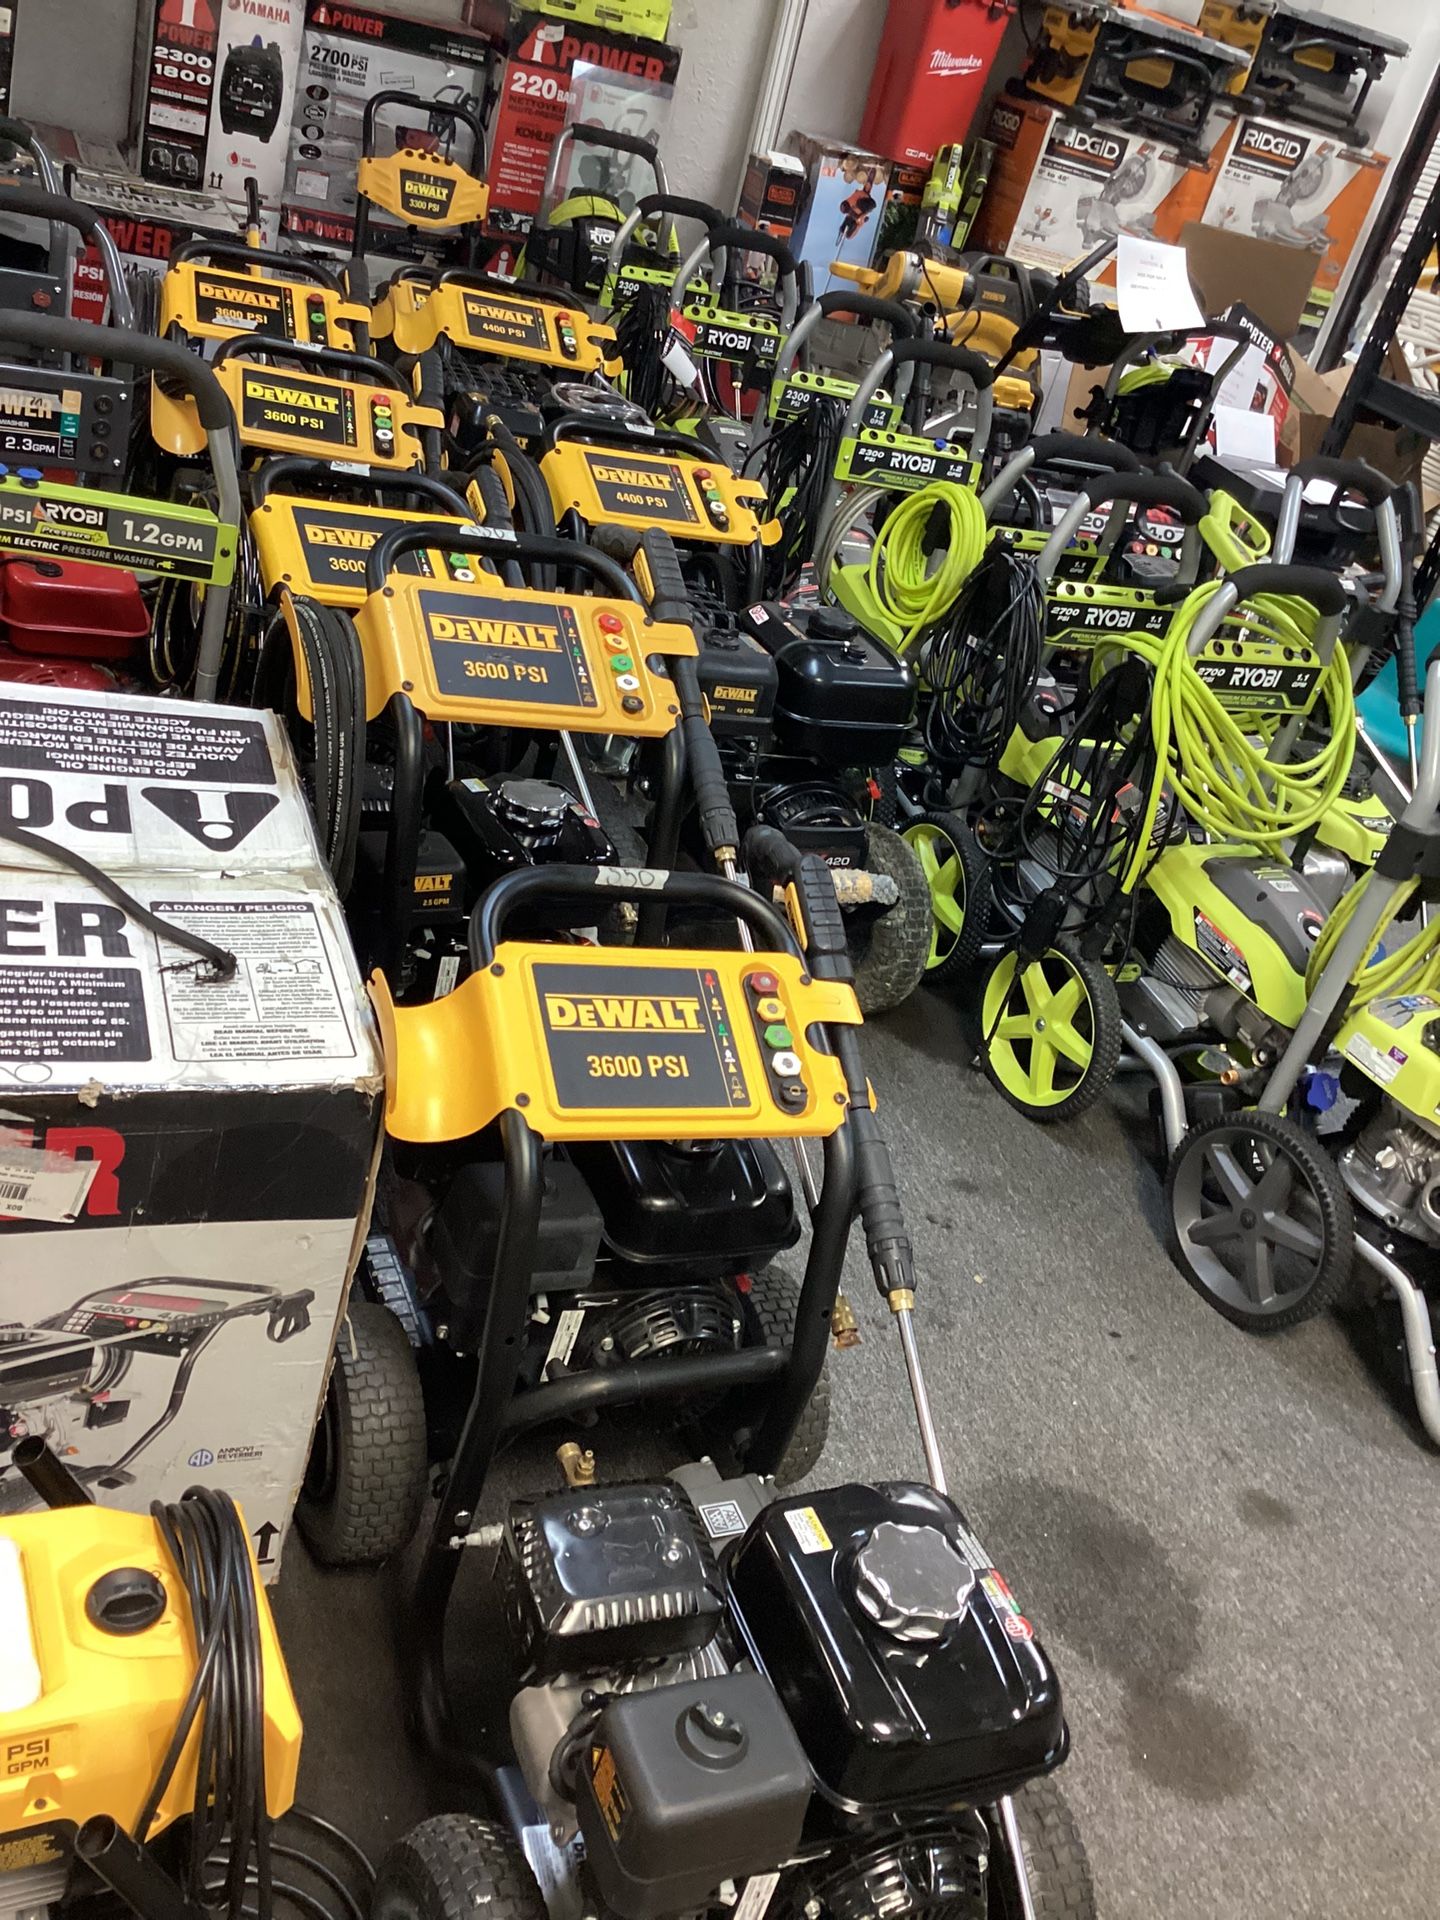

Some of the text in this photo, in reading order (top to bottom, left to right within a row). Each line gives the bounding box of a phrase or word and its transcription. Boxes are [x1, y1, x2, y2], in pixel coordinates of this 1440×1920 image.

[242, 0, 290, 24] YAMAHA
[158, 22, 213, 51] POWER
[154, 46, 212, 69] 2300
[311, 45, 350, 68] 2700
[930, 49, 983, 69] Milwaukee
[351, 58, 368, 73] PSI
[154, 63, 212, 86] 1800
[511, 71, 558, 99] 220
[1242, 128, 1301, 158] RIDGID
[409, 199, 441, 212] 3300 PSI
[78, 265, 104, 281] PSI
[618, 280, 640, 292] 2300
[199, 285, 280, 311] DEWALT
[246, 312, 268, 325] PSI
[466, 303, 535, 327] DEWALT
[483, 322, 526, 338] 4400 PSI
[707, 329, 752, 351] RYOBI
[763, 338, 775, 348] 1.2
[246, 382, 339, 415] DEWALT
[785, 389, 810, 403] 2300
[0, 393, 52, 419] WER
[264, 409, 324, 430] 3600 PSI
[873, 409, 886, 420] 1.2
[858, 448, 885, 458] 2300
[889, 452, 936, 475] RYOBI
[949, 464, 964, 472] 1.2
[591, 465, 673, 490] DEWALT
[616, 491, 668, 508] 4400 PSI
[3, 507, 31, 524] PSI
[46, 503, 104, 526] RYOBI
[14, 537, 155, 567] ELECTRIC PRESSURE WASHER
[1051, 606, 1080, 617] 2700
[1085, 607, 1136, 629] RYOBI
[1150, 615, 1163, 624] 1.1
[429, 614, 559, 650] DEWALT
[463, 660, 549, 684] 3600 PSI
[1197, 667, 1225, 677] 2700
[1229, 667, 1283, 688] RYOBI
[1296, 673, 1310, 681] 1.1
[714, 686, 758, 702] DEWALT
[43, 707, 190, 726] ACEITE DE MOTOR!
[73, 718, 216, 736] FUNCIONAMIENTO
[88, 727, 109, 735] EL
[113, 729, 168, 740] PONER
[0, 737, 69, 750] MOTEUR
[70, 735, 92, 743] EN
[97, 736, 162, 748] METTRE
[74, 743, 136, 755] L'HUILE
[166, 750, 238, 761] AJOUTEZ
[191, 744, 244, 754] AVANT
[46, 752, 196, 770] BEFORE RUNNING!
[56, 760, 188, 777] ADD ENGINE OIL
[825, 857, 850, 866] 420
[173, 904, 236, 912] DANGER
[245, 904, 308, 912] PELIGRO
[49, 970, 104, 979] Unleaded
[19, 986, 59, 996] Rating
[28, 978, 55, 986] With
[70, 980, 126, 988] Minimum
[41, 999, 99, 1007] l'essence
[548, 998, 702, 1031] DEWALT
[104, 1030, 124, 1038] sin
[62, 1040, 117, 1048] octanaje
[587, 1055, 689, 1078] 3600 PSI
[7, 1738, 50, 1761] PSI
[7, 1757, 49, 1775] GPM
